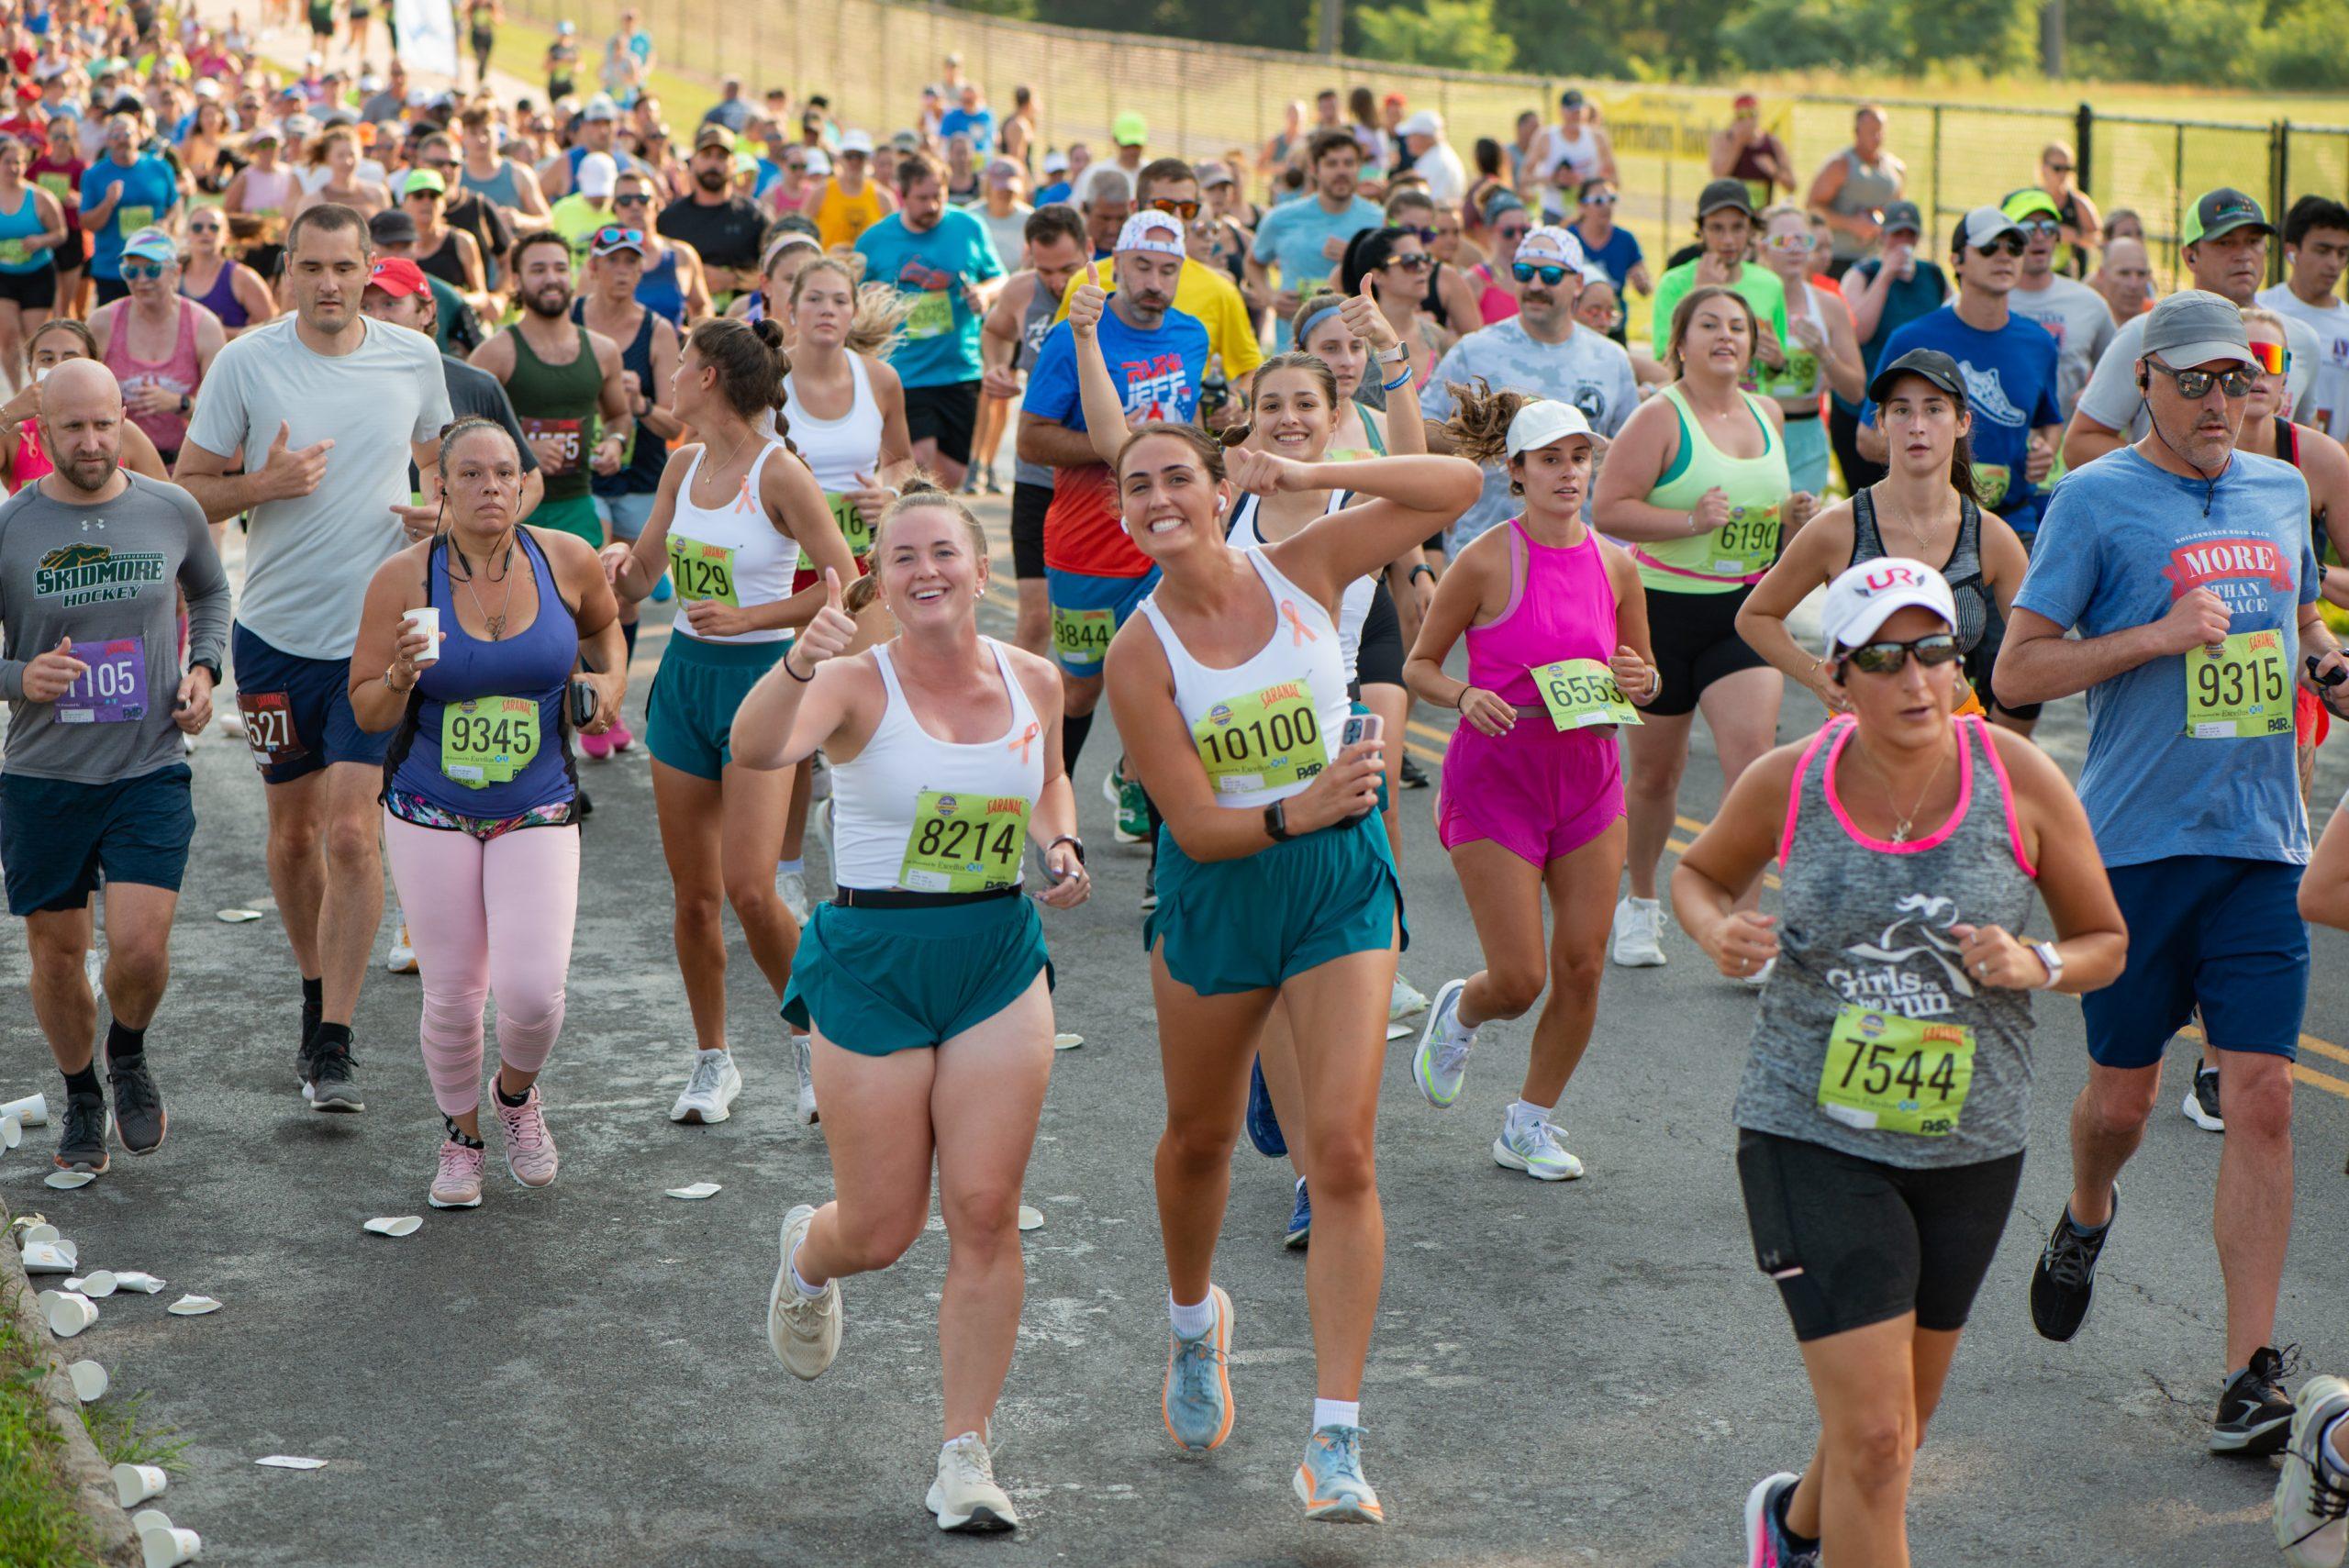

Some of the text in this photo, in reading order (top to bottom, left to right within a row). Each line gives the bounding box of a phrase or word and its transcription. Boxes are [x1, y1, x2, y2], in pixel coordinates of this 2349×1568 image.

[1123, 370, 1186, 414] JEFF
[1721, 521, 1776, 550] 6190
[34, 559, 165, 597] SKIDMORE
[672, 553, 729, 596] 7129
[2181, 545, 2276, 579] MORE
[1866, 567, 1915, 590] UR
[2211, 582, 2261, 598] THAN
[62, 585, 143, 608] HOCKEY
[2224, 597, 2268, 614] RACE
[1054, 620, 1110, 648] 9844
[1259, 683, 1303, 710] SARANAC
[1549, 675, 1625, 707] 6553
[2198, 657, 2282, 707] 9315
[451, 717, 531, 755] 9345
[1202, 706, 1317, 763] 10100
[1296, 762, 1323, 781] PAR
[985, 797, 1023, 817] SARANAC
[918, 818, 1016, 864] 8214
[1826, 964, 1922, 998] Girls
[1856, 992, 1954, 1018] he run
[1840, 1037, 1955, 1101] 7544
